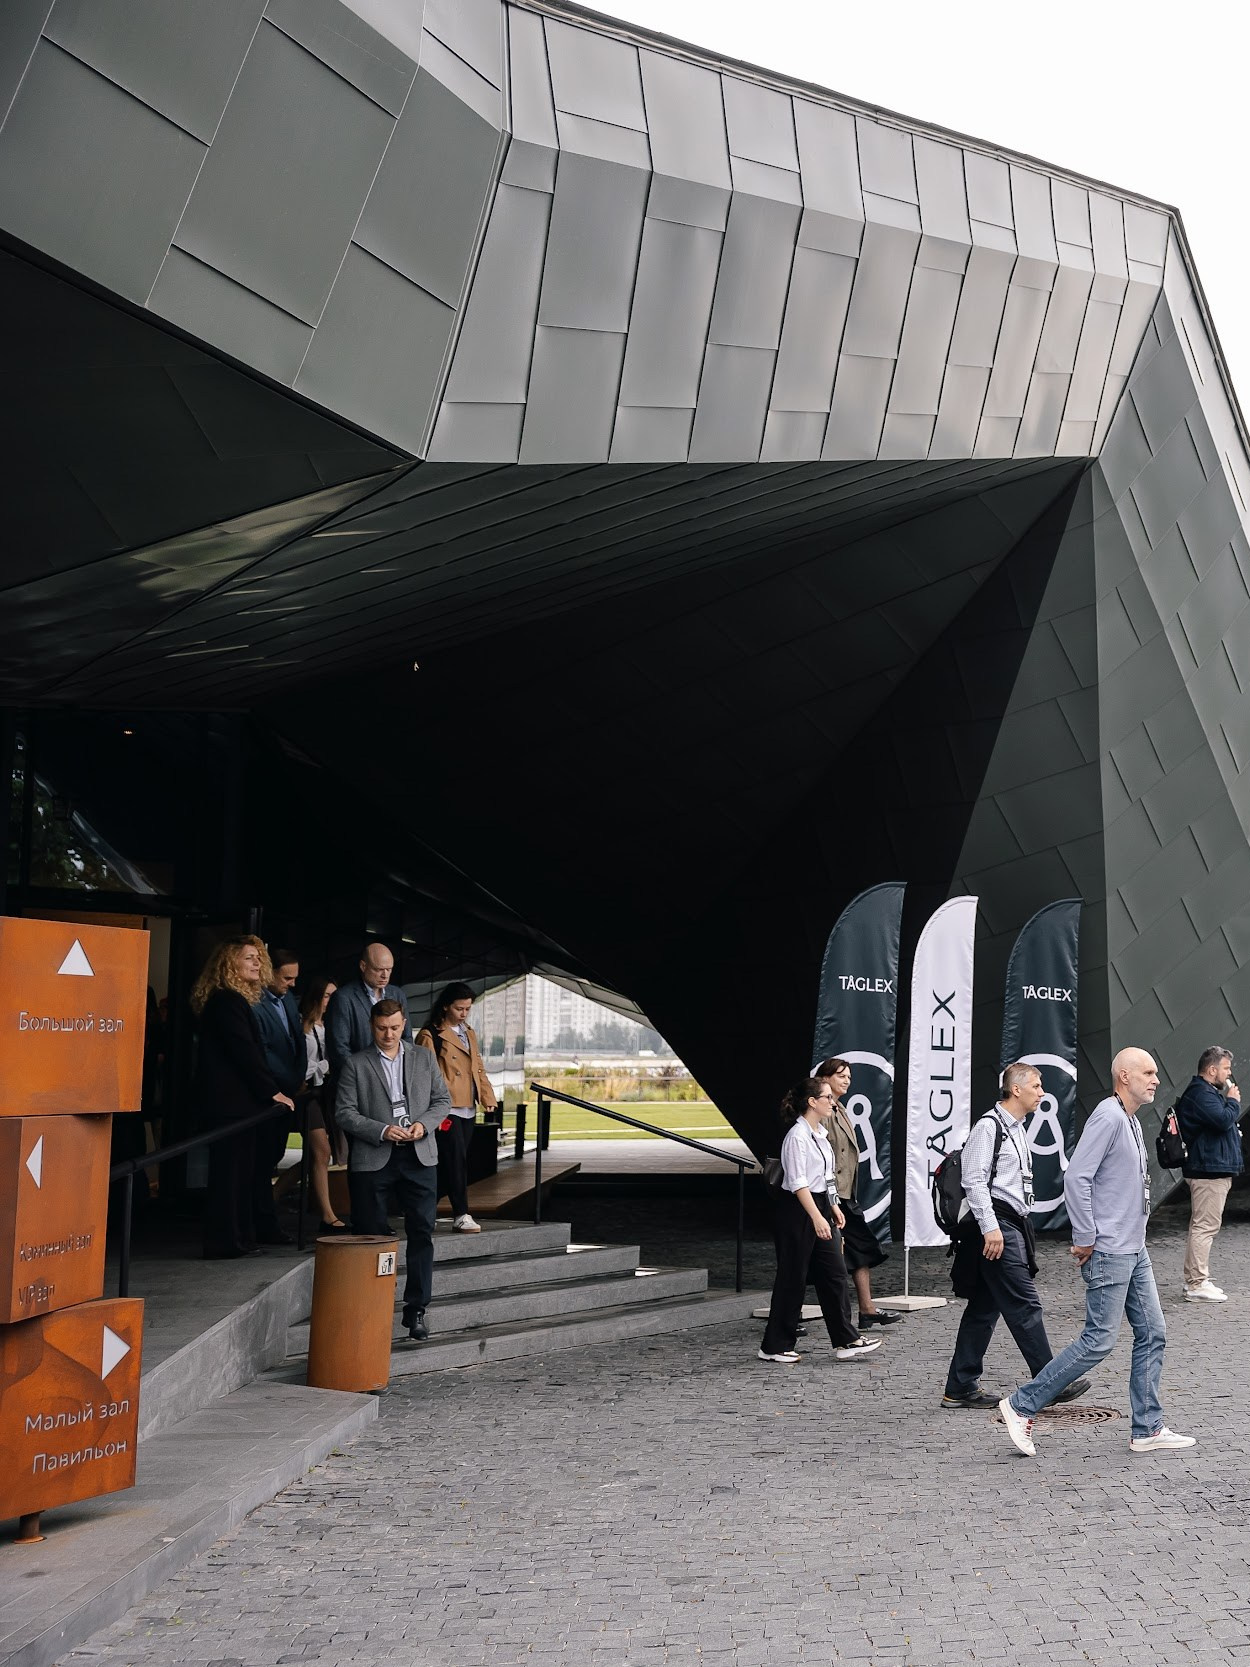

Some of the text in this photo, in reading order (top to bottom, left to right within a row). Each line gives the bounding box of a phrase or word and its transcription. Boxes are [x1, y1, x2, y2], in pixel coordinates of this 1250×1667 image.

[838, 974, 893, 994] TÅGLEX
[1021, 984, 1073, 1002] TÅGLEX
[19, 1010, 124, 1033] Большой зал
[25, 1400, 129, 1435] Малый зал
[32, 1440, 127, 1475] Павильон
